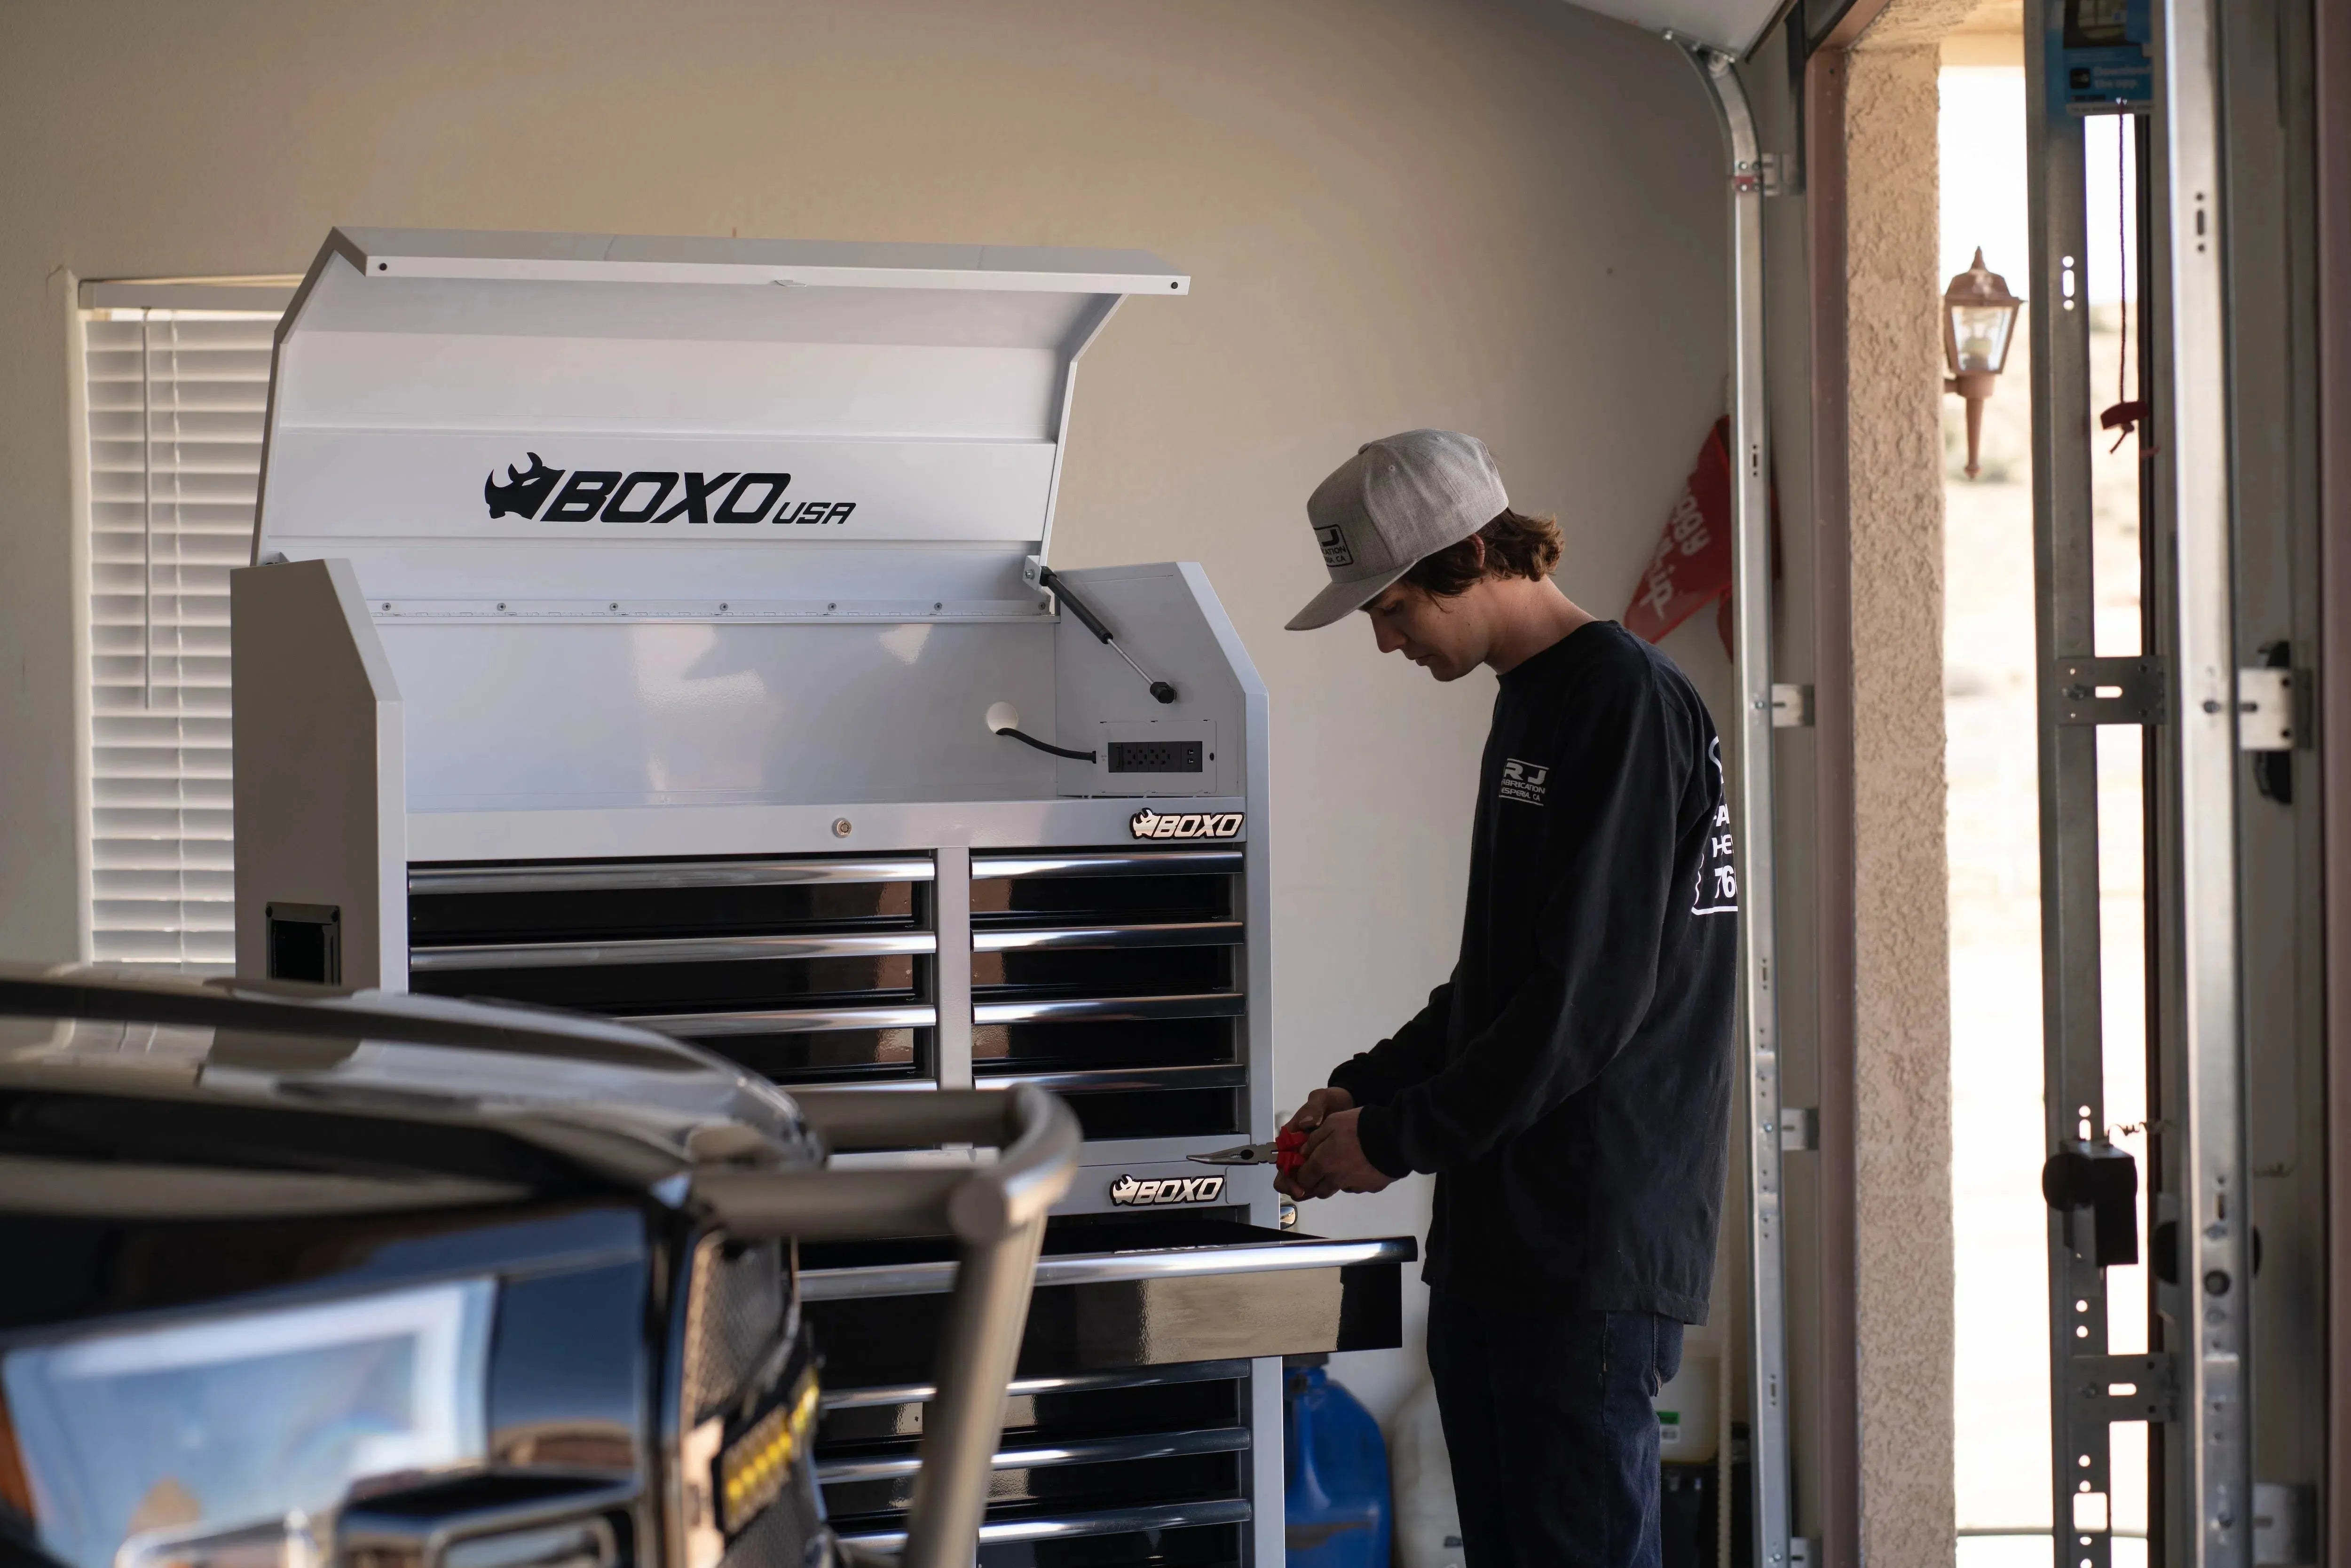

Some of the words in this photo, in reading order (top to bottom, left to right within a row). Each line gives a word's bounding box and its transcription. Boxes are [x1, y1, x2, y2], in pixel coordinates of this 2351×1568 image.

[540, 471, 791, 524] BOXO
[772, 502, 857, 525] USA
[1501, 778, 1546, 794] ABRICATION
[1152, 814, 1244, 837] BOXO
[1712, 834, 1734, 858] HE
[1714, 865, 1738, 898] 76
[1132, 1177, 1223, 1204] BOXO
